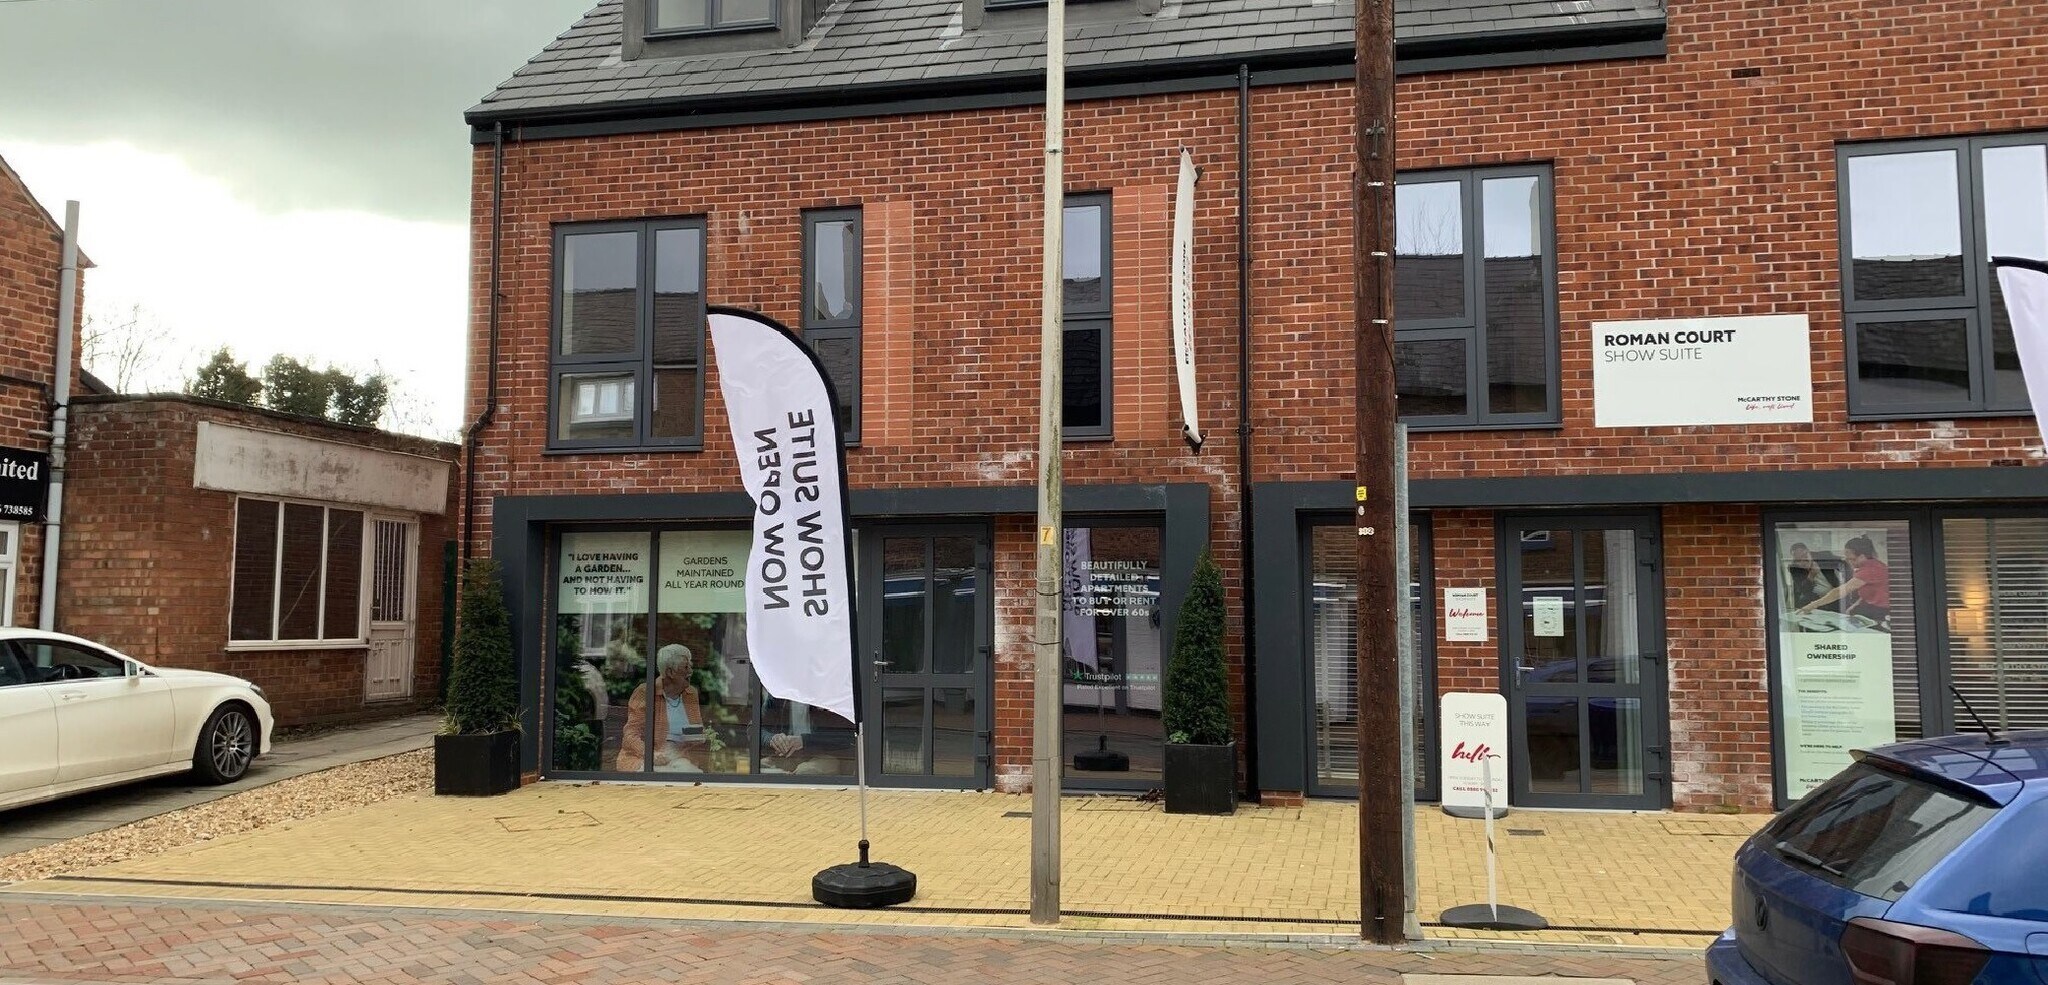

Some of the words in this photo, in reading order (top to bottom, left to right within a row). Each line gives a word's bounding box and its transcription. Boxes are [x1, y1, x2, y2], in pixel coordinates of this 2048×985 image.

[1604, 332, 1670, 347] ROMAN
[1674, 329, 1737, 344] COURT
[1604, 349, 1655, 363] SHOW
[1659, 347, 1703, 361] SUITE
[0, 457, 38, 480] ited
[1042, 527, 1051, 541] 7
[577, 553, 600, 561] LOVE
[603, 552, 639, 561] HAVING
[683, 556, 728, 565] GARDENS
[1081, 560, 1148, 570] BEAUTIFULLY
[677, 568, 735, 577] MAINTAINED
[1090, 573, 1138, 581] DETAILED
[563, 576, 583, 584] AND
[607, 575, 644, 583] HAVING
[665, 580, 682, 588] ALL
[684, 580, 708, 588] YEAR
[710, 579, 745, 588] ROUND
[574, 587, 587, 595] TO
[1080, 584, 1149, 592] APARTMENTS
[1072, 597, 1087, 605] TO
[1089, 597, 1110, 605] BUY
[1113, 597, 1127, 605] OR
[1129, 597, 1157, 605] RENT
[1080, 608, 1100, 617] FOR
[1101, 608, 1129, 617] OVER
[1131, 608, 1150, 617] 60s
[1085, 672, 1122, 682] Trustpilot
